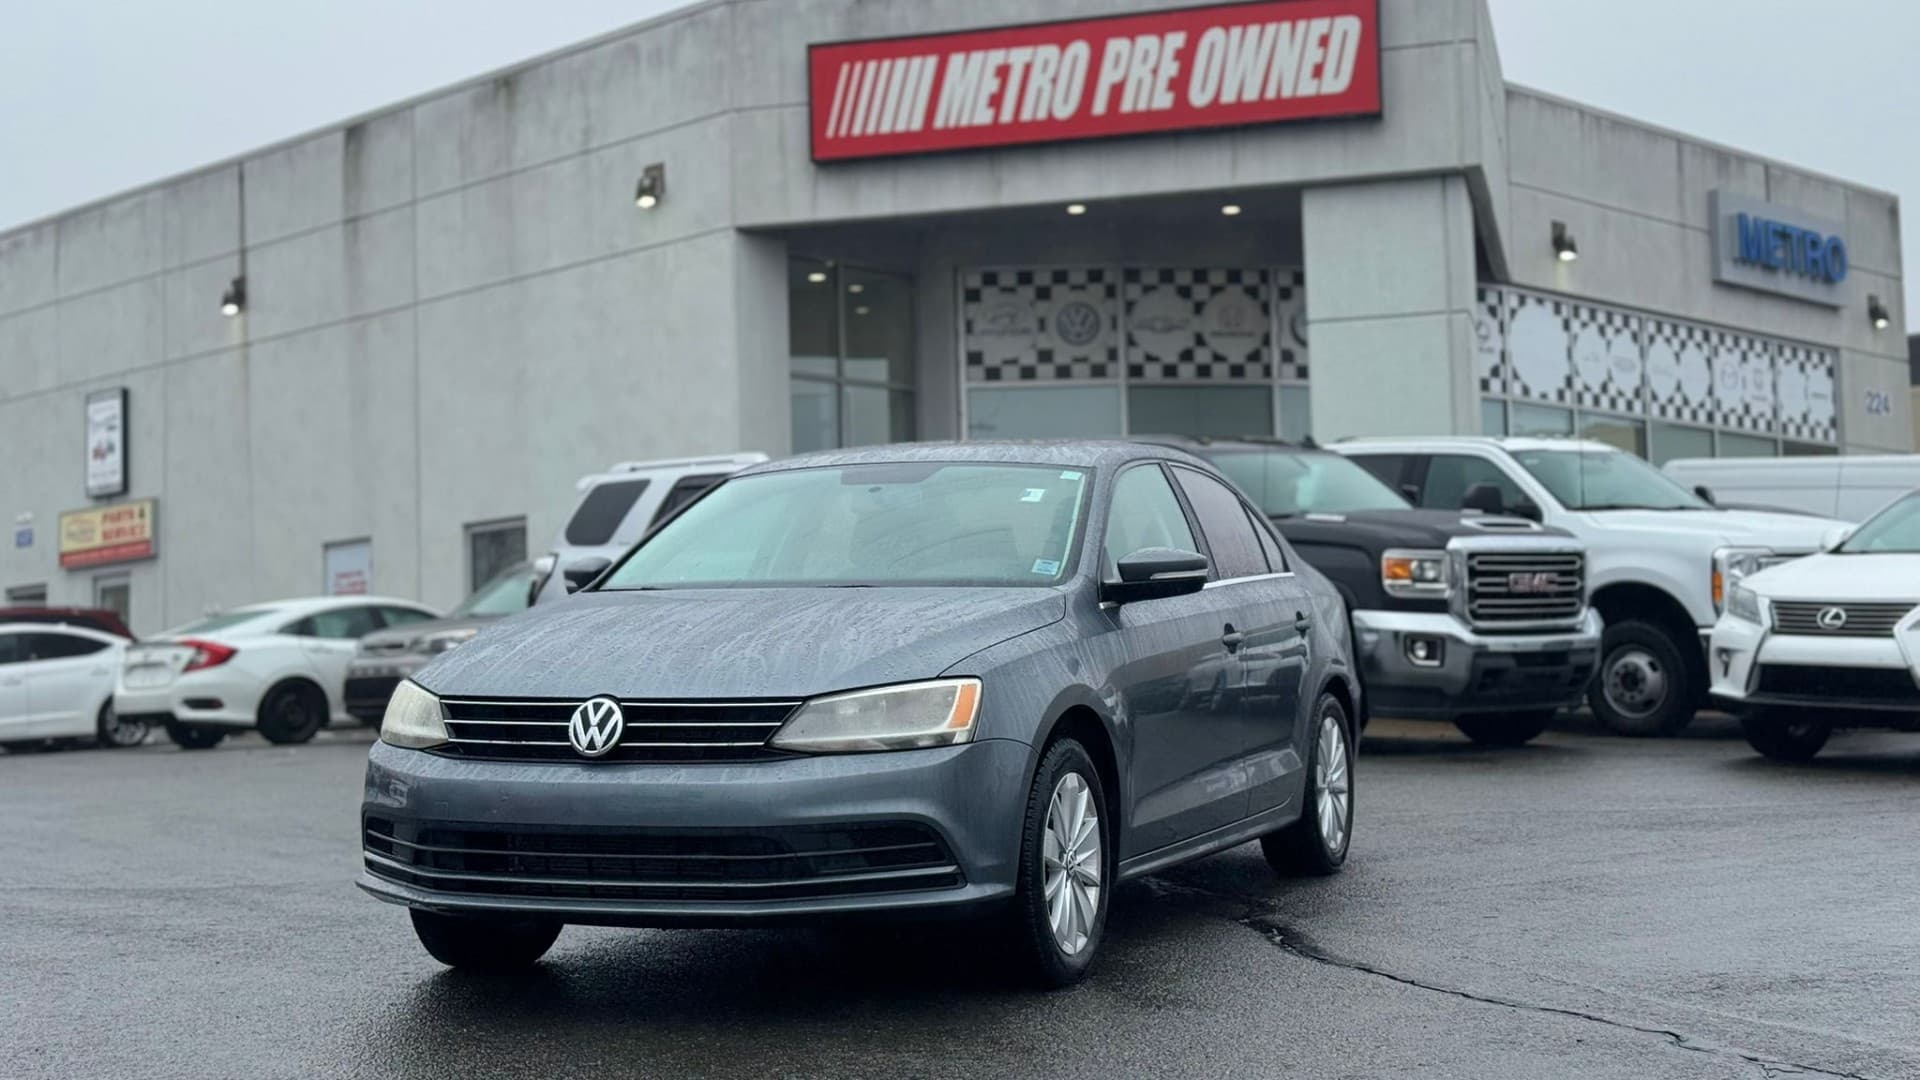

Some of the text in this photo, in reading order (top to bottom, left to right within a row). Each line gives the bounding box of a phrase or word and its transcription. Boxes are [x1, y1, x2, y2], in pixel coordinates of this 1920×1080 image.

[932, 15, 1362, 130] METRO PRE OWNED
[1738, 212, 1848, 283] METRO
[1865, 389, 1890, 414] 224
[1508, 572, 1559, 593] GMC
